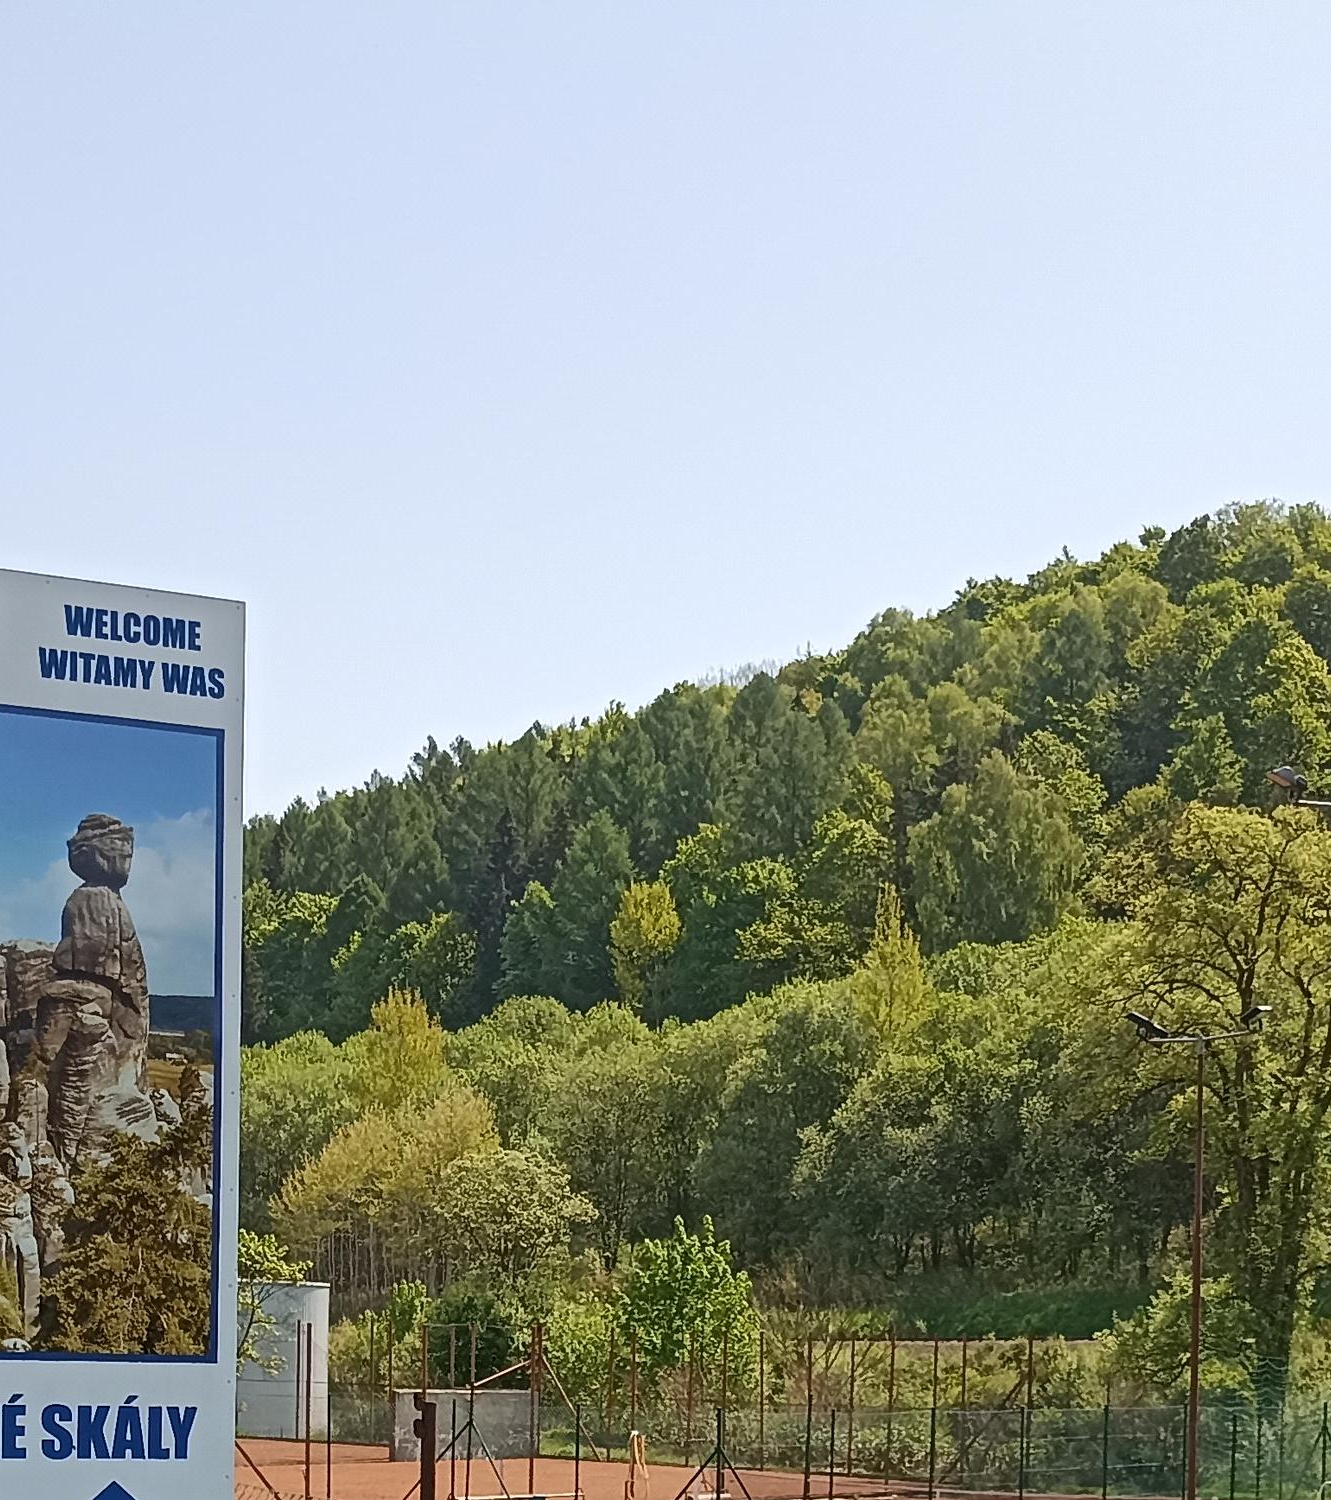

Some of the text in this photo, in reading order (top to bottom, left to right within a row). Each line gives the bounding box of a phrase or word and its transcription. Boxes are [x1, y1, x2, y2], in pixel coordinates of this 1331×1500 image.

[64, 604, 202, 652] WELCOME
[38, 646, 225, 700] WITAMY WAS
[41, 1395, 198, 1460] SKÁLY
